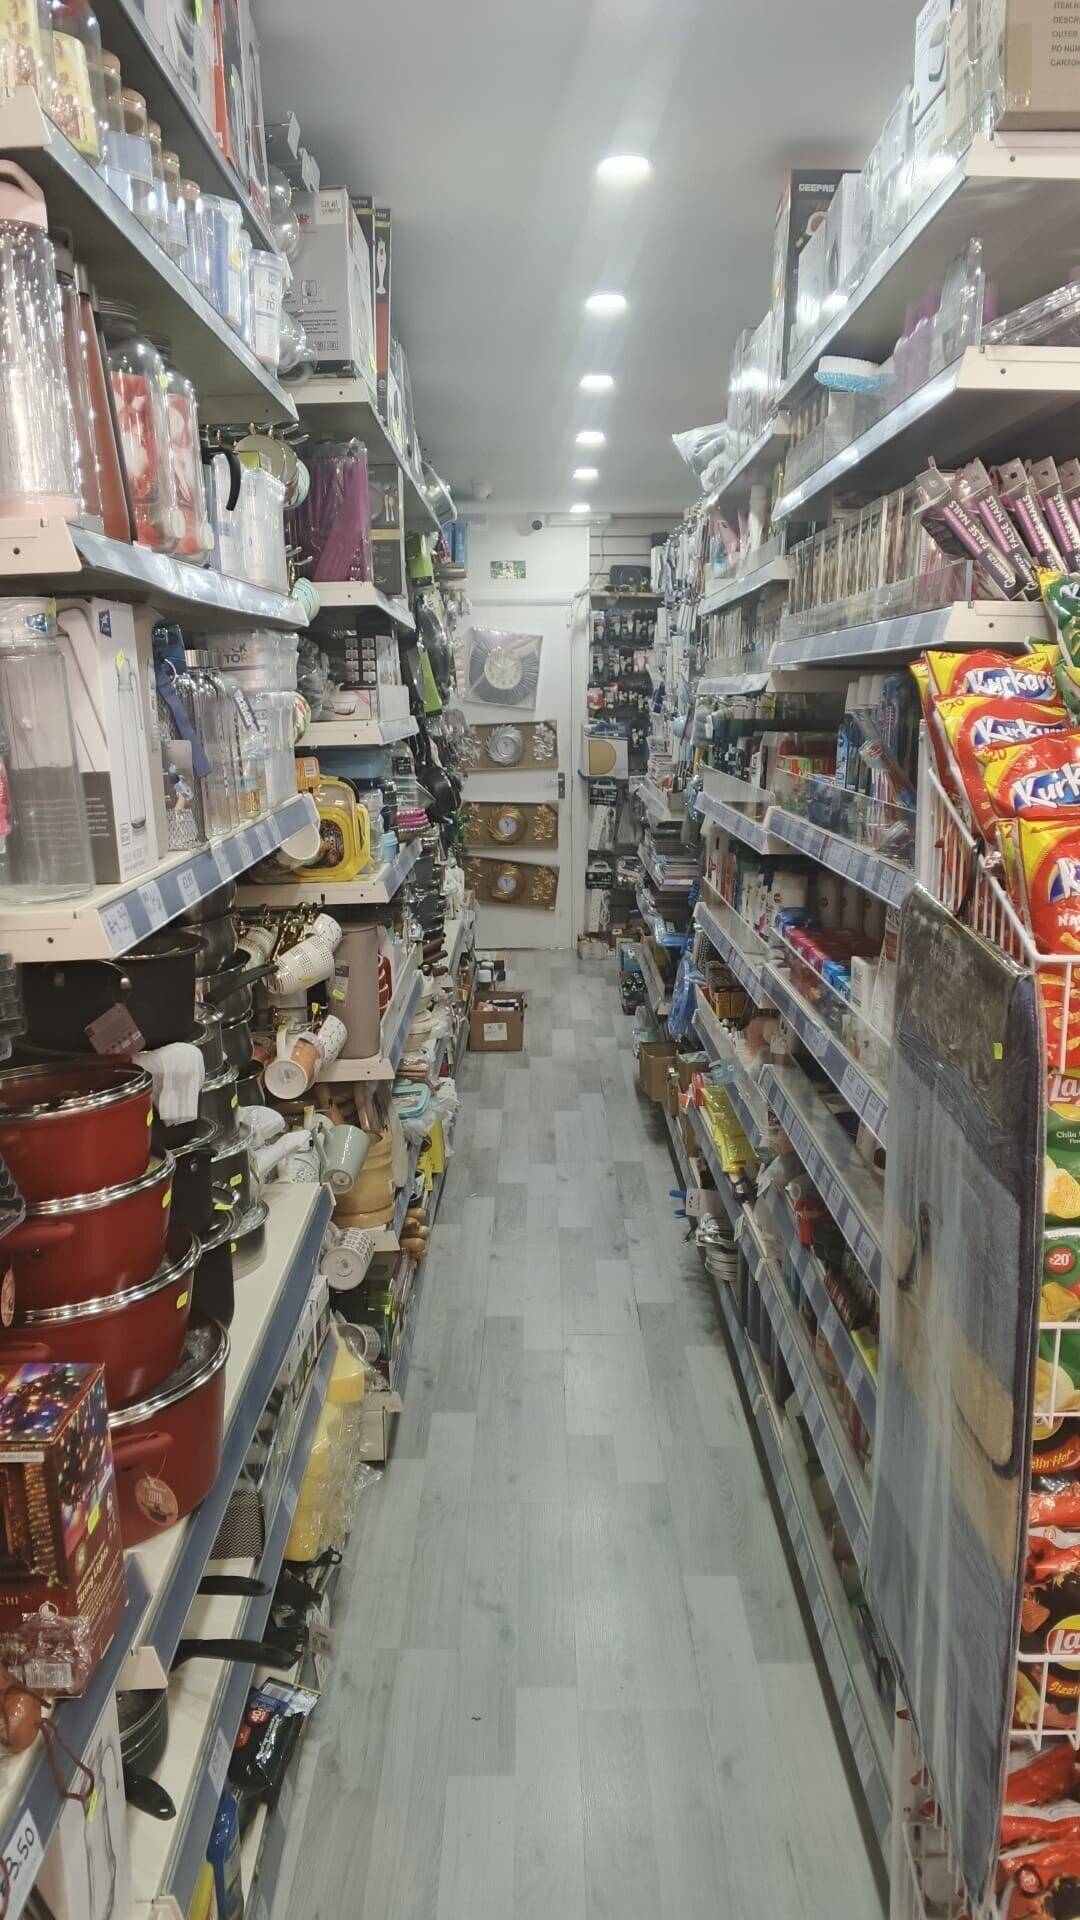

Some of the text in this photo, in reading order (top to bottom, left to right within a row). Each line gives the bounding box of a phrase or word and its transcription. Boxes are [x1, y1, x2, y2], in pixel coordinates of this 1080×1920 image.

[798, 183, 835, 193] GEEPAS
[948, 500, 973, 526] NAILS
[985, 495, 1006, 522] NAILS
[1022, 494, 1039, 521] NAILS
[1053, 493, 1070, 521] NAILS
[968, 526, 991, 550] FALSE
[1001, 522, 1020, 549] FALSE
